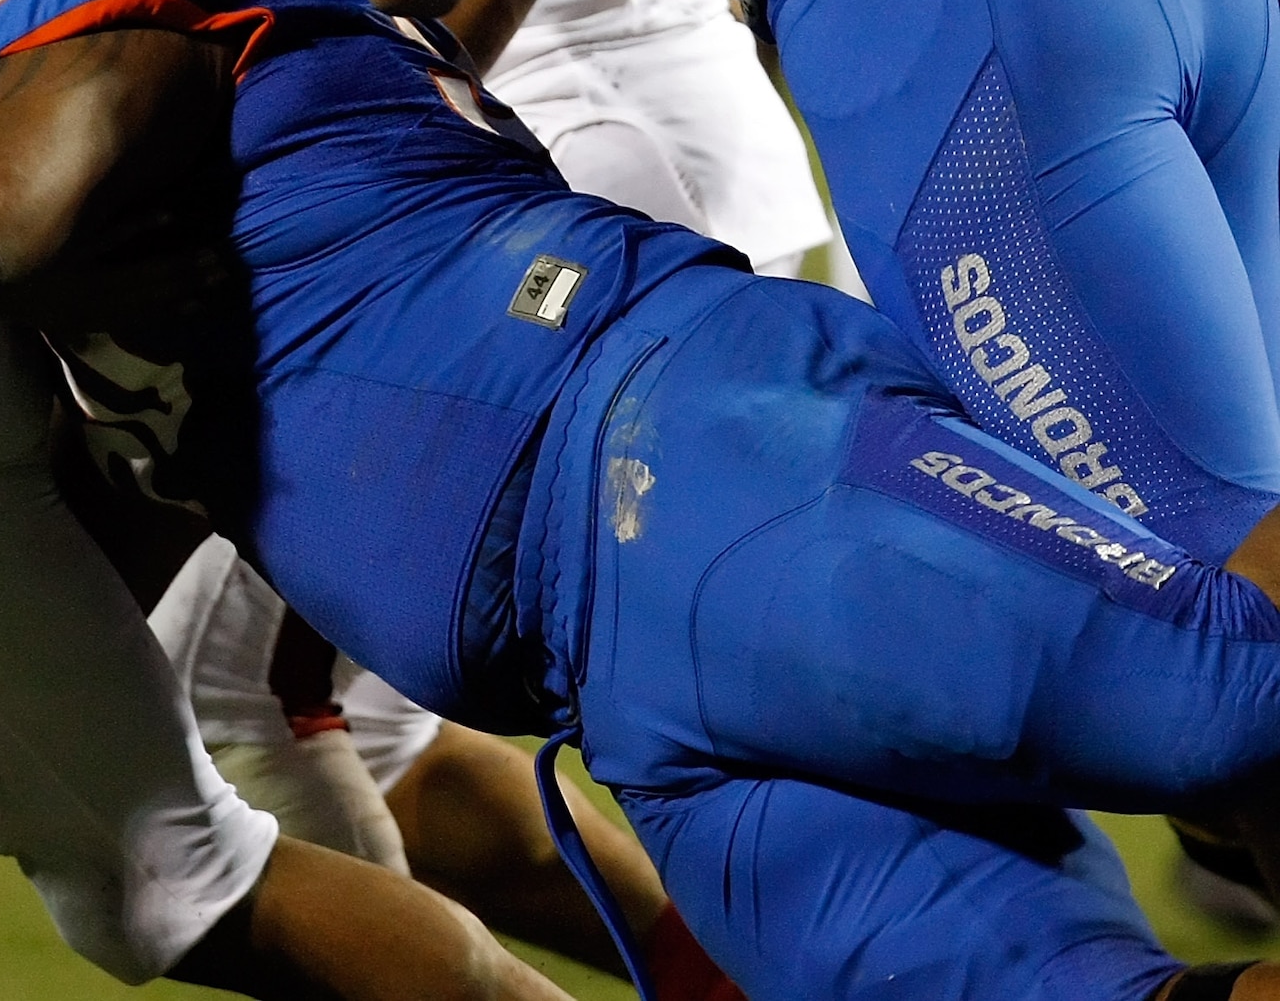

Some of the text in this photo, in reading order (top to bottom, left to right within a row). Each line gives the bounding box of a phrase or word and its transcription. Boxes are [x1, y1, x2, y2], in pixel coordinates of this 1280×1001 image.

[527, 275, 550, 300] 44
[940, 253, 1148, 518] BRONCOS
[909, 451, 1176, 590] BRONCOS
